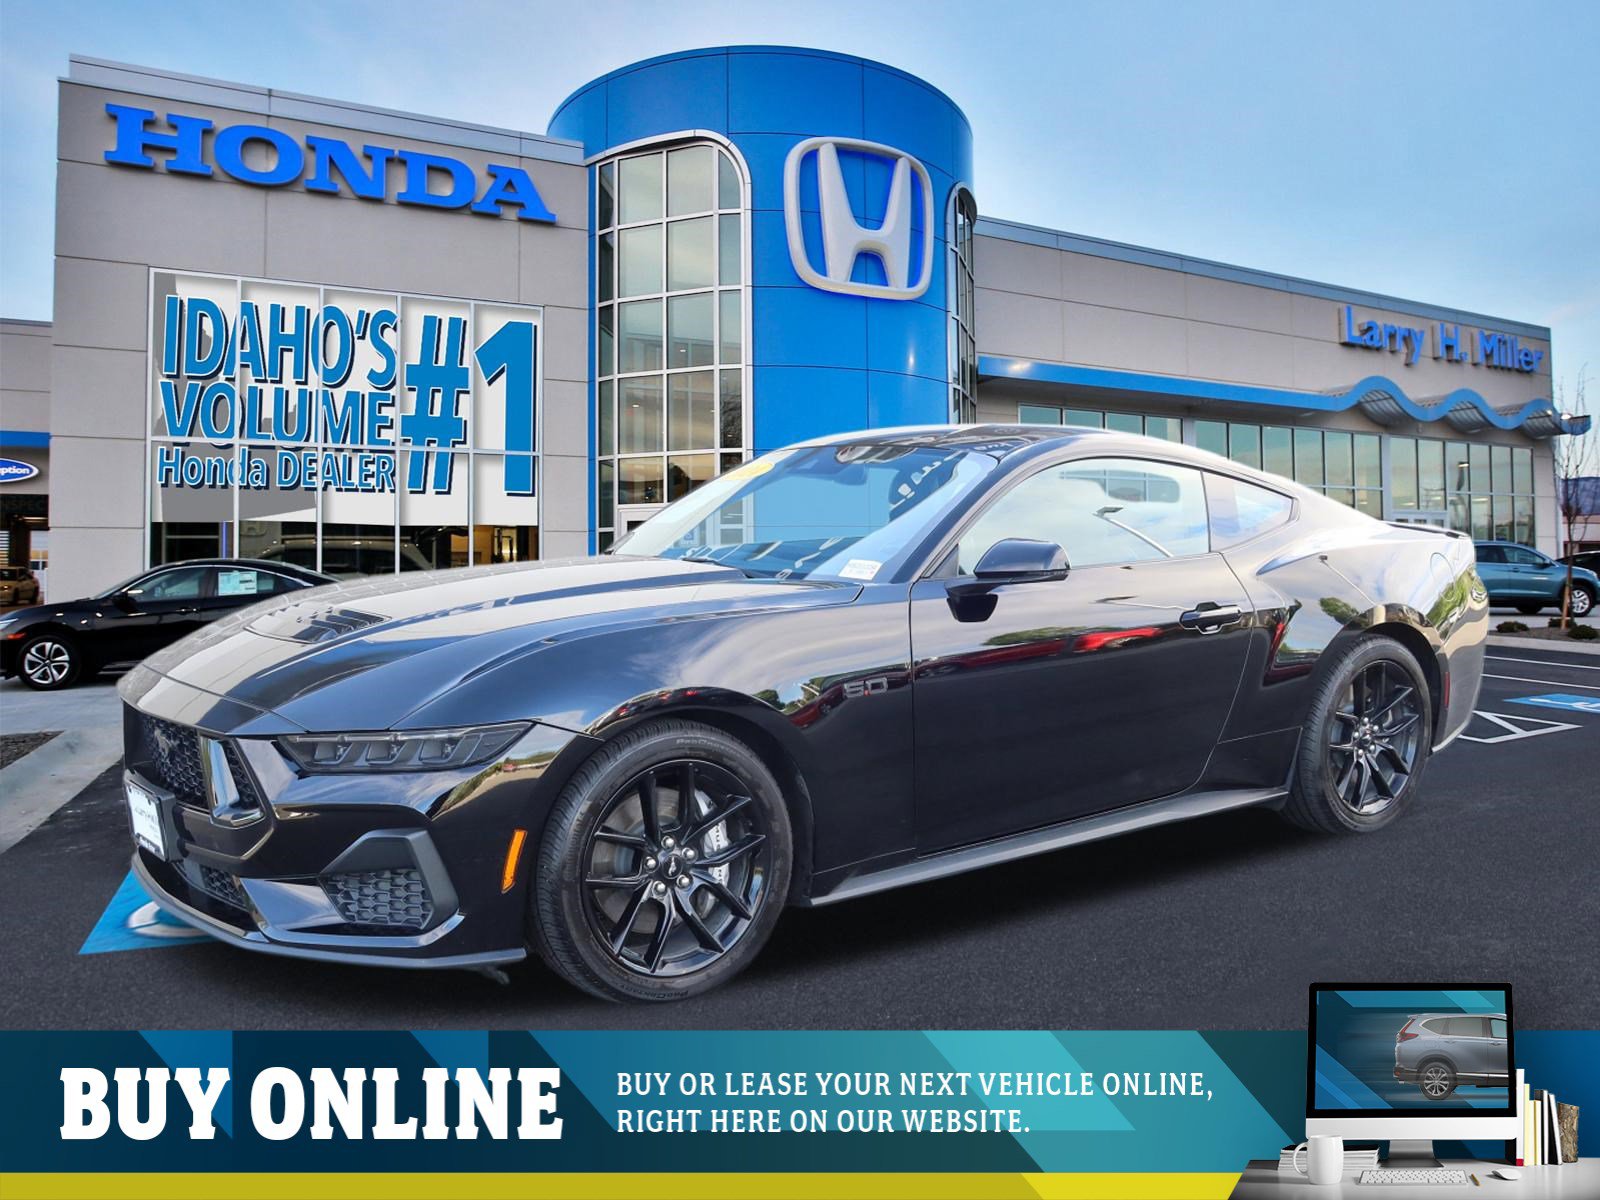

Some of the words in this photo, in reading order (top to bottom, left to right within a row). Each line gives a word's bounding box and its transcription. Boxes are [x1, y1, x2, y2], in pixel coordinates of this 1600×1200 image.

[104, 103, 557, 224] HONDA
[162, 294, 399, 391] IDAHO'S
[1342, 305, 1425, 366] Larry
[1436, 323, 1468, 361] H.
[1475, 329, 1545, 373] Miller
[159, 379, 397, 450] VOLUME
[400, 314, 538, 497] #1
[156, 446, 269, 490] Honda
[275, 451, 397, 493] DEALER
